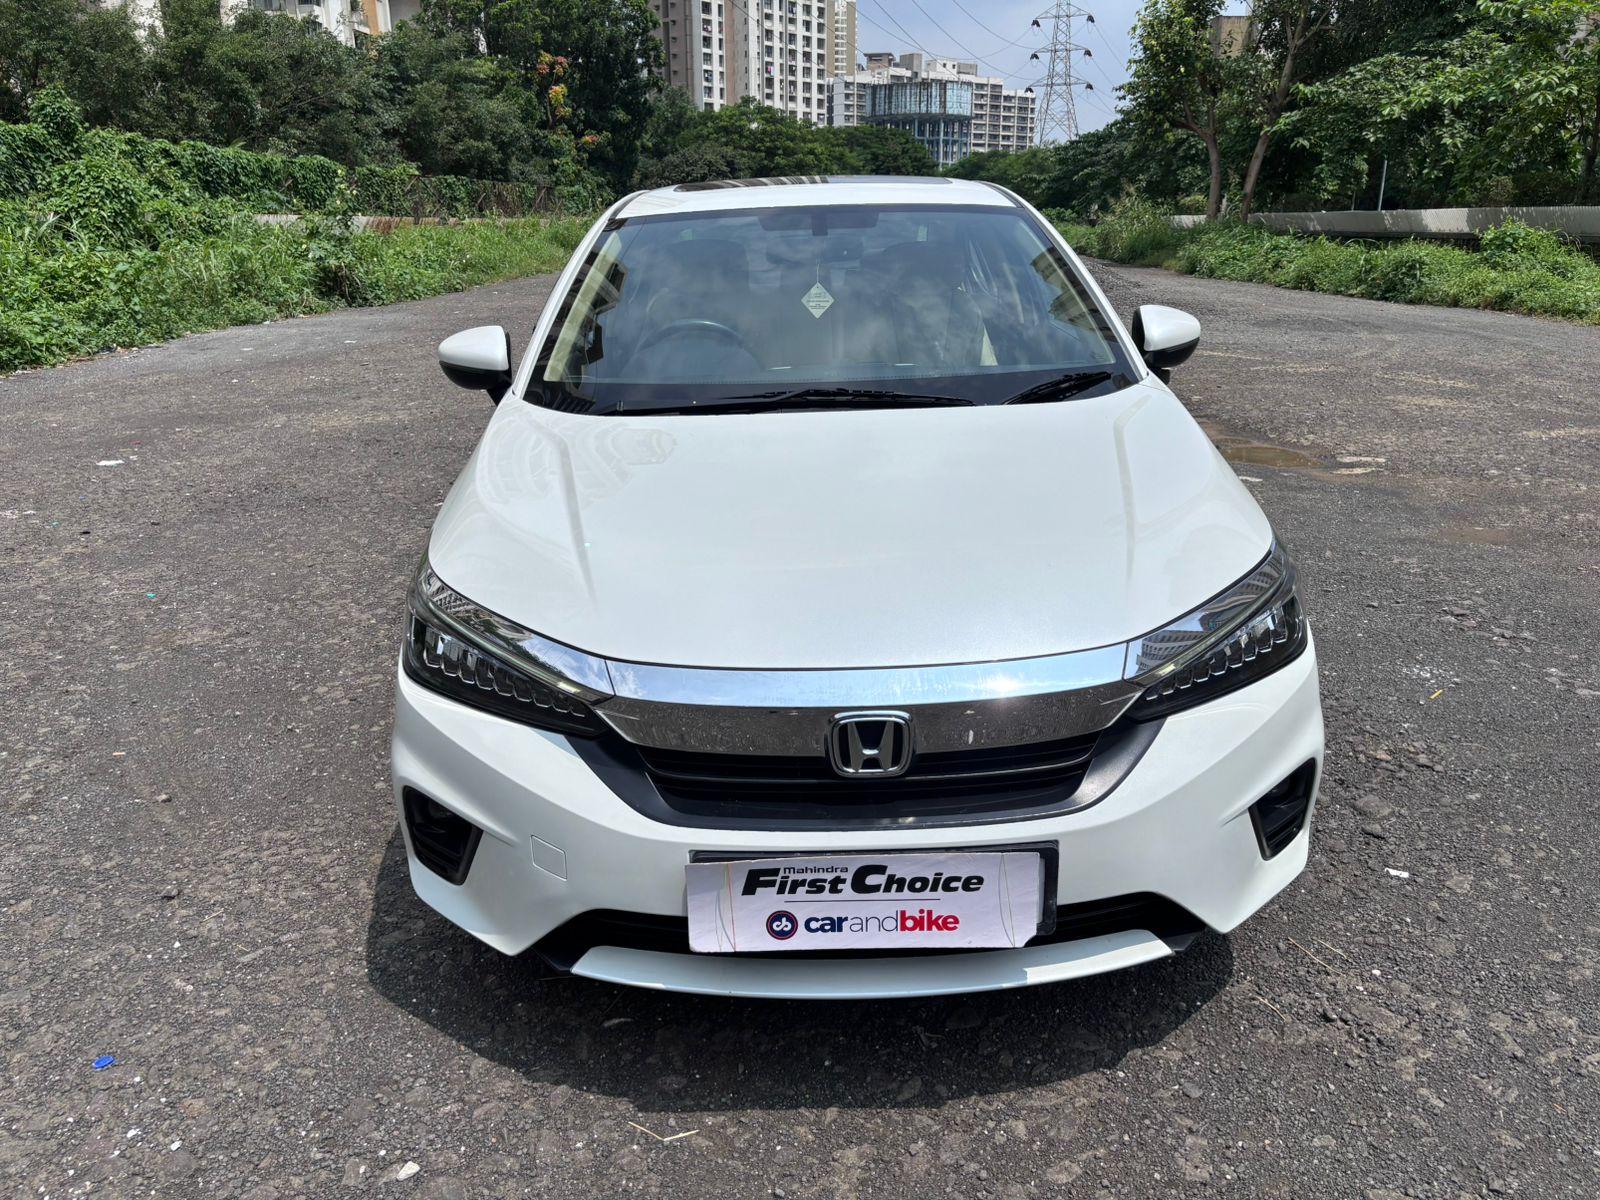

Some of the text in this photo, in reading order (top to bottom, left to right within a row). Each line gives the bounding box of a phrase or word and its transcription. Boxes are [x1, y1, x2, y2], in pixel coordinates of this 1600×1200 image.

[741, 864, 985, 896] First Choice
[783, 865, 848, 875] Mahindra
[804, 908, 960, 934] carandbike
